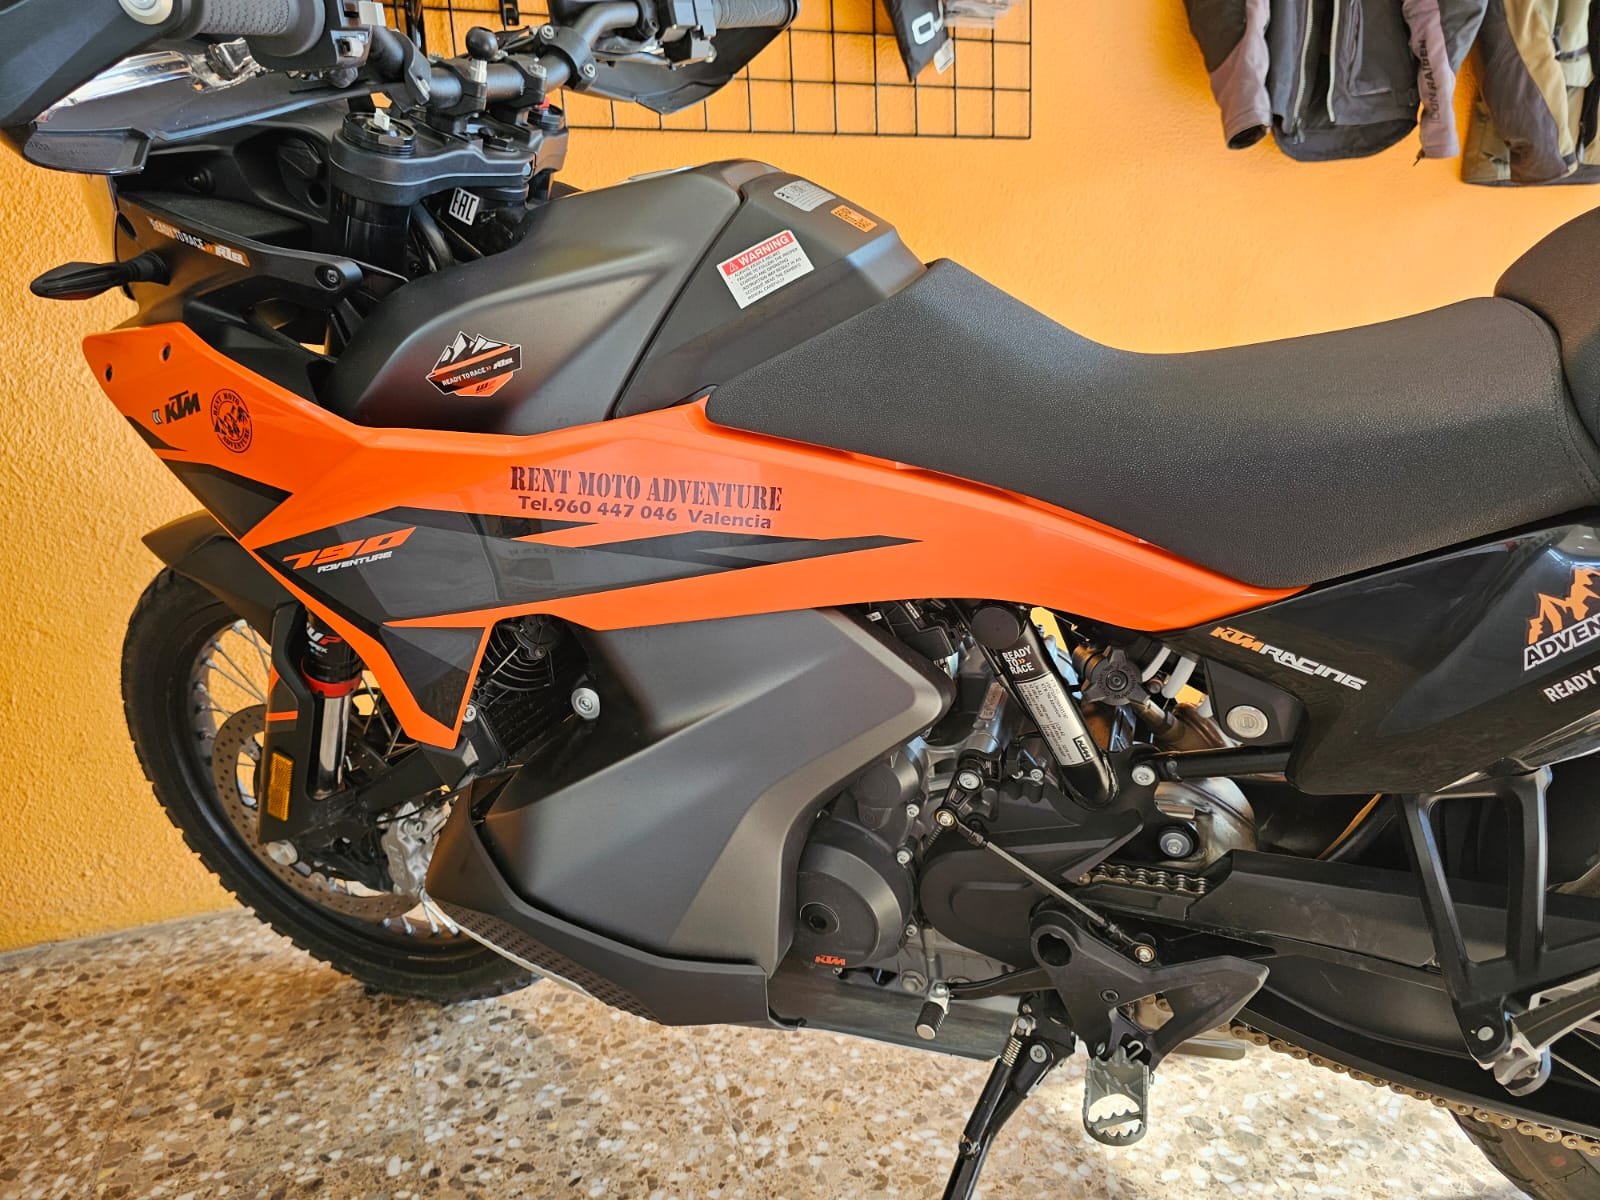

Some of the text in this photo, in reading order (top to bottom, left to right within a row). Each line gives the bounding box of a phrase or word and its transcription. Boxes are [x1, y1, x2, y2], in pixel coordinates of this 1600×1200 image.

[451, 190, 477, 221] EAC
[738, 235, 790, 266] WARNING
[164, 390, 201, 424] KTM
[510, 466, 783, 511] RENT MOTO ADVENTURE
[518, 496, 771, 529] Tel.960 447 046 Valencia
[282, 527, 417, 570] 790
[317, 551, 393, 573] ADVENTURE
[1002, 645, 1032, 660] READY
[1006, 657, 1019, 668] TO
[1010, 662, 1035, 674] RACE
[1543, 669, 1597, 702] READY
